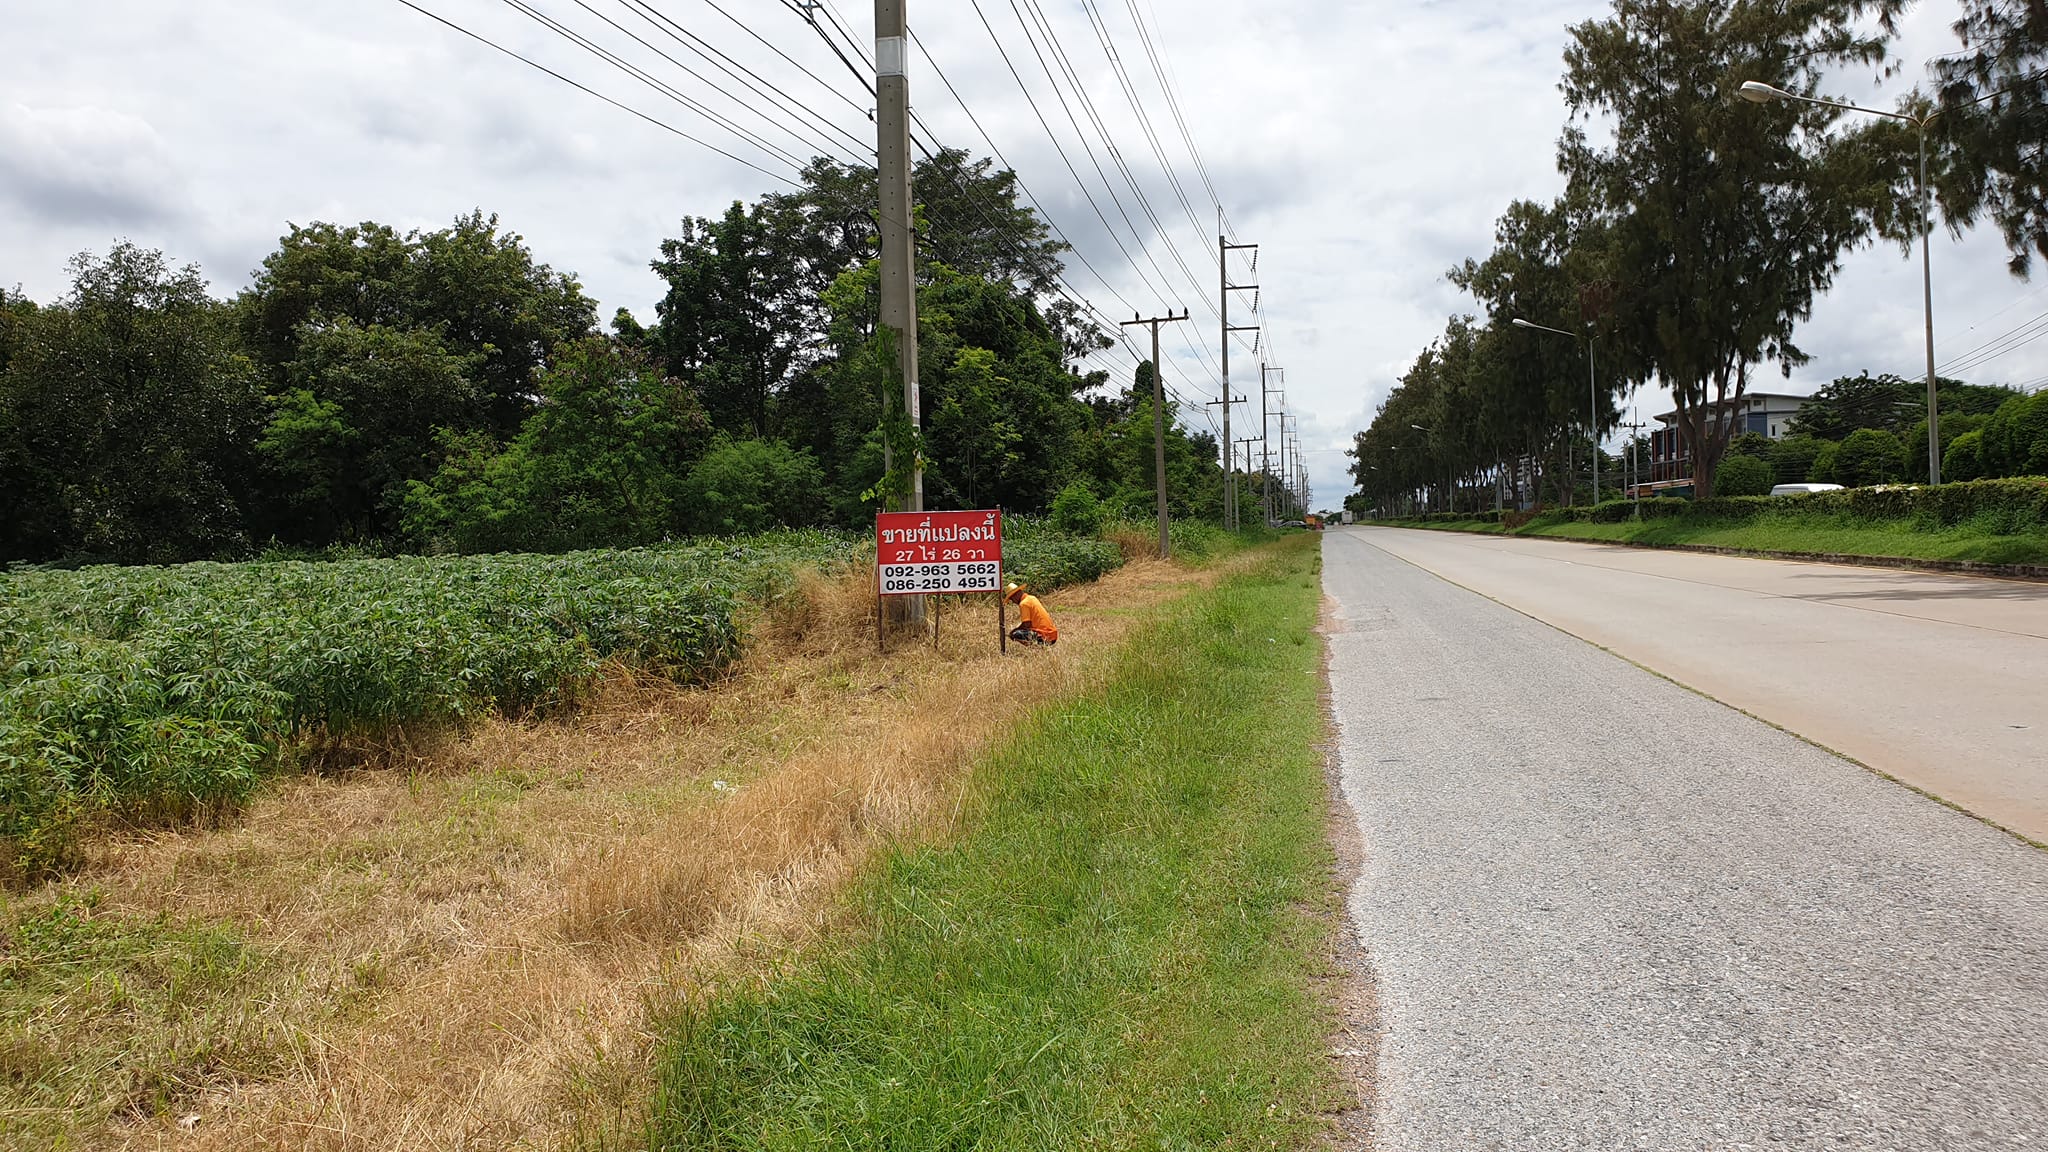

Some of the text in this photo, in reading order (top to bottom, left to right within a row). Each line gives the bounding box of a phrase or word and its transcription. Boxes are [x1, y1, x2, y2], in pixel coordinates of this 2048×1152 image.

[882, 513, 995, 543] ขายที่แปลงนี้
[896, 545, 985, 561] 27 ไร่ 26 วา
[885, 563, 996, 577] 092-963 5662
[886, 577, 995, 590] 086-250 4951
